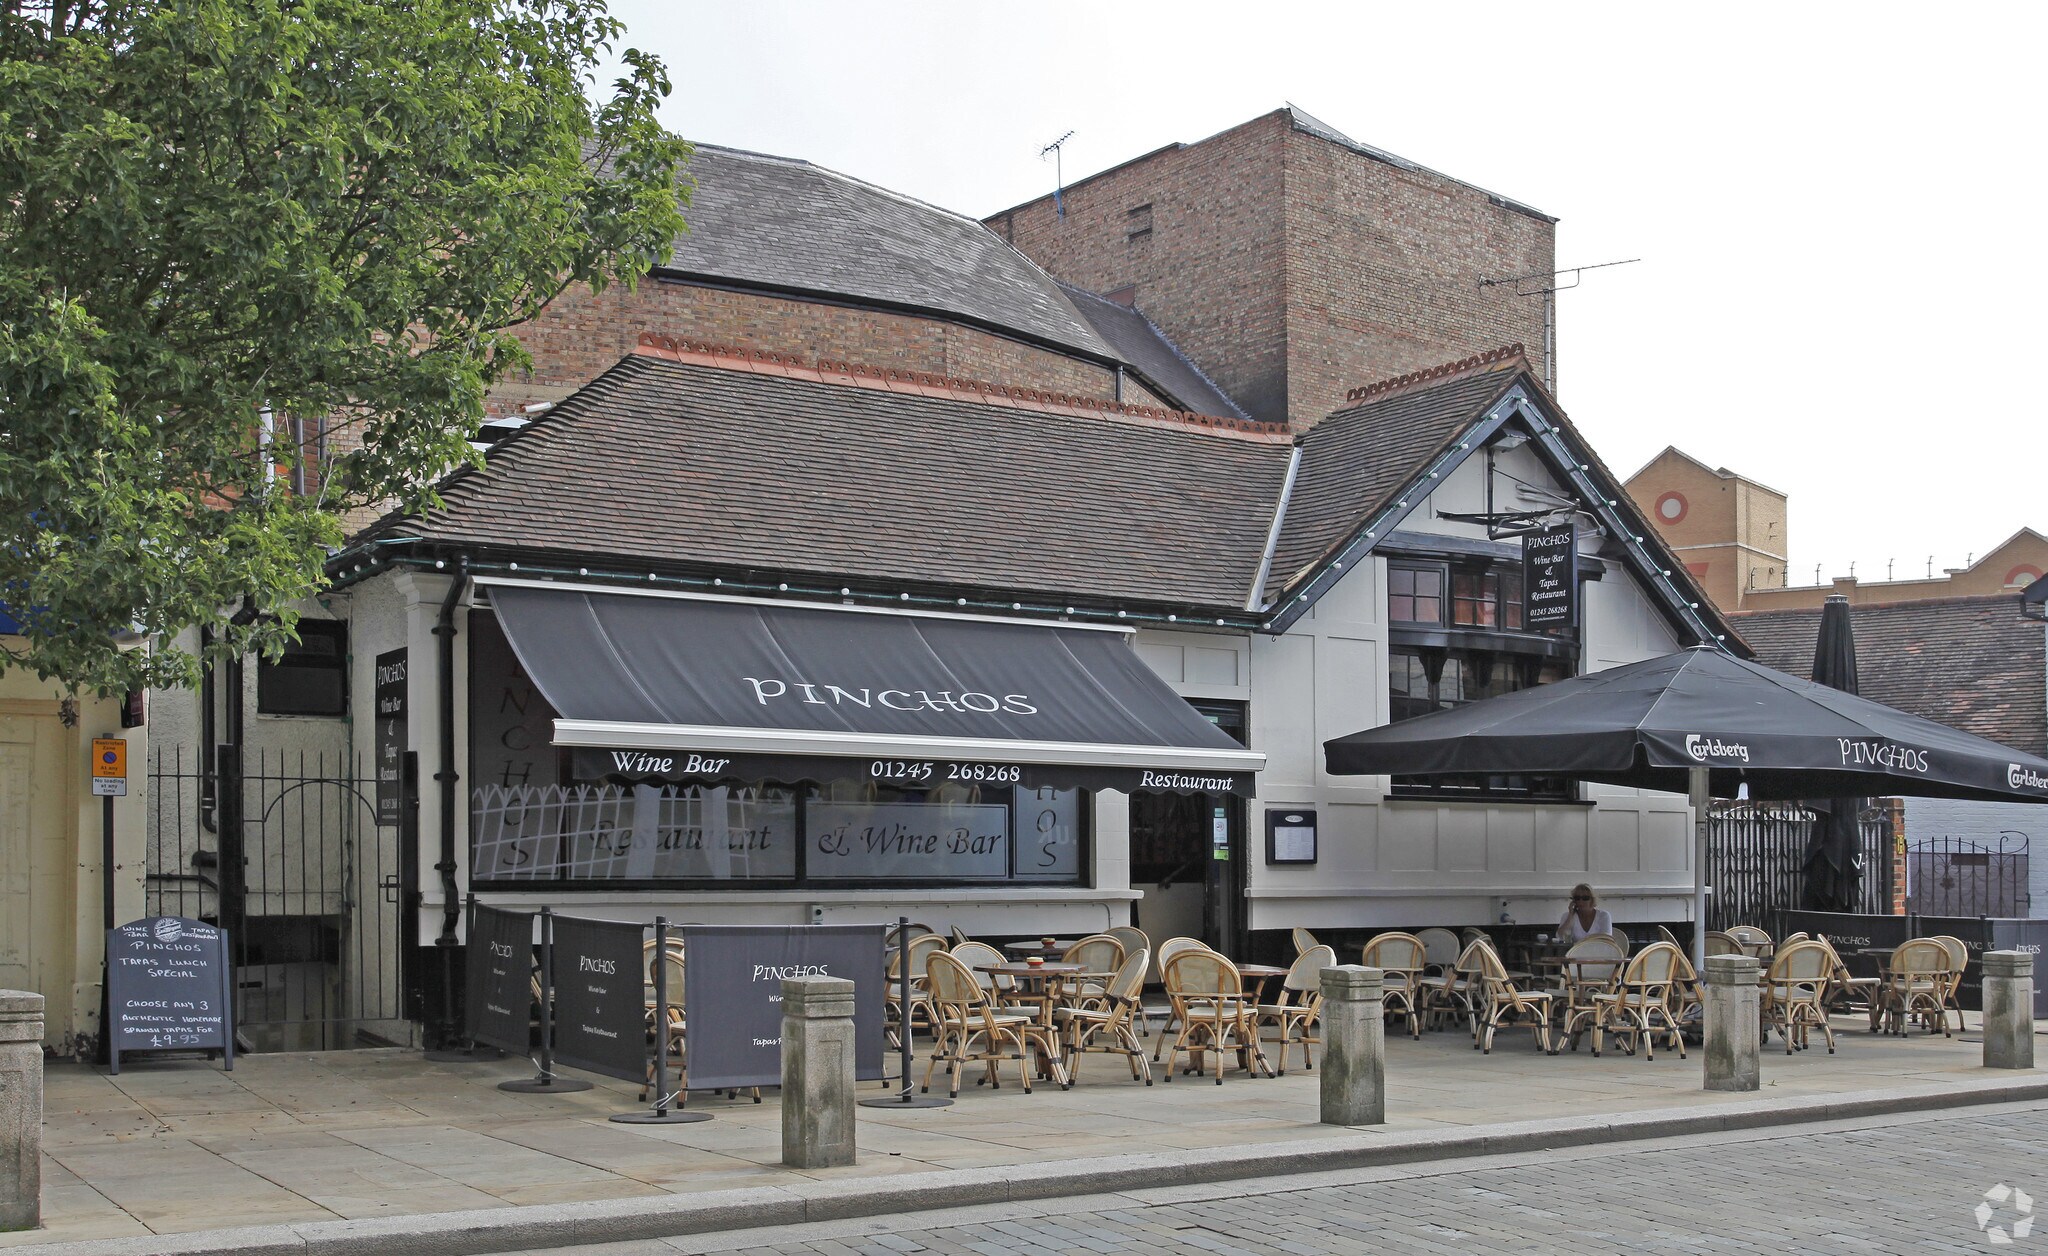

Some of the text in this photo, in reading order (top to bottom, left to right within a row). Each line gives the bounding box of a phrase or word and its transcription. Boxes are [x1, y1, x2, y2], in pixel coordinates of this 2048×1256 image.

[1528, 533, 1570, 550] PINCHOS
[1534, 556, 1550, 565] Wine
[1545, 566, 1553, 576] &
[1539, 579, 1558, 589] Tapas
[1531, 590, 1566, 601] Restaurant
[1530, 606, 1567, 616] 01245 268268
[378, 660, 406, 688] PINCHOS
[742, 678, 1038, 715] PINCHOS
[1686, 734, 1749, 762] Carlsberg
[1838, 738, 1928, 772] PINCHOS
[611, 751, 730, 773] Wine Bar
[870, 760, 1020, 782] 01245 268268
[2008, 763, 2048, 788] Carlsber
[1140, 771, 1234, 791] Restaurant
[860, 824, 938, 857] Wine
[947, 827, 1002, 855] Bar
[130, 941, 201, 952] PINCHOS
[1827, 934, 1870, 946] PINCHOS
[148, 969, 197, 978] SPECIAL
[580, 955, 615, 975] PINCHOS
[753, 965, 828, 982] PINCHOS
[200, 1001, 208, 1010] 3
[753, 1038, 776, 1047] Tapas
